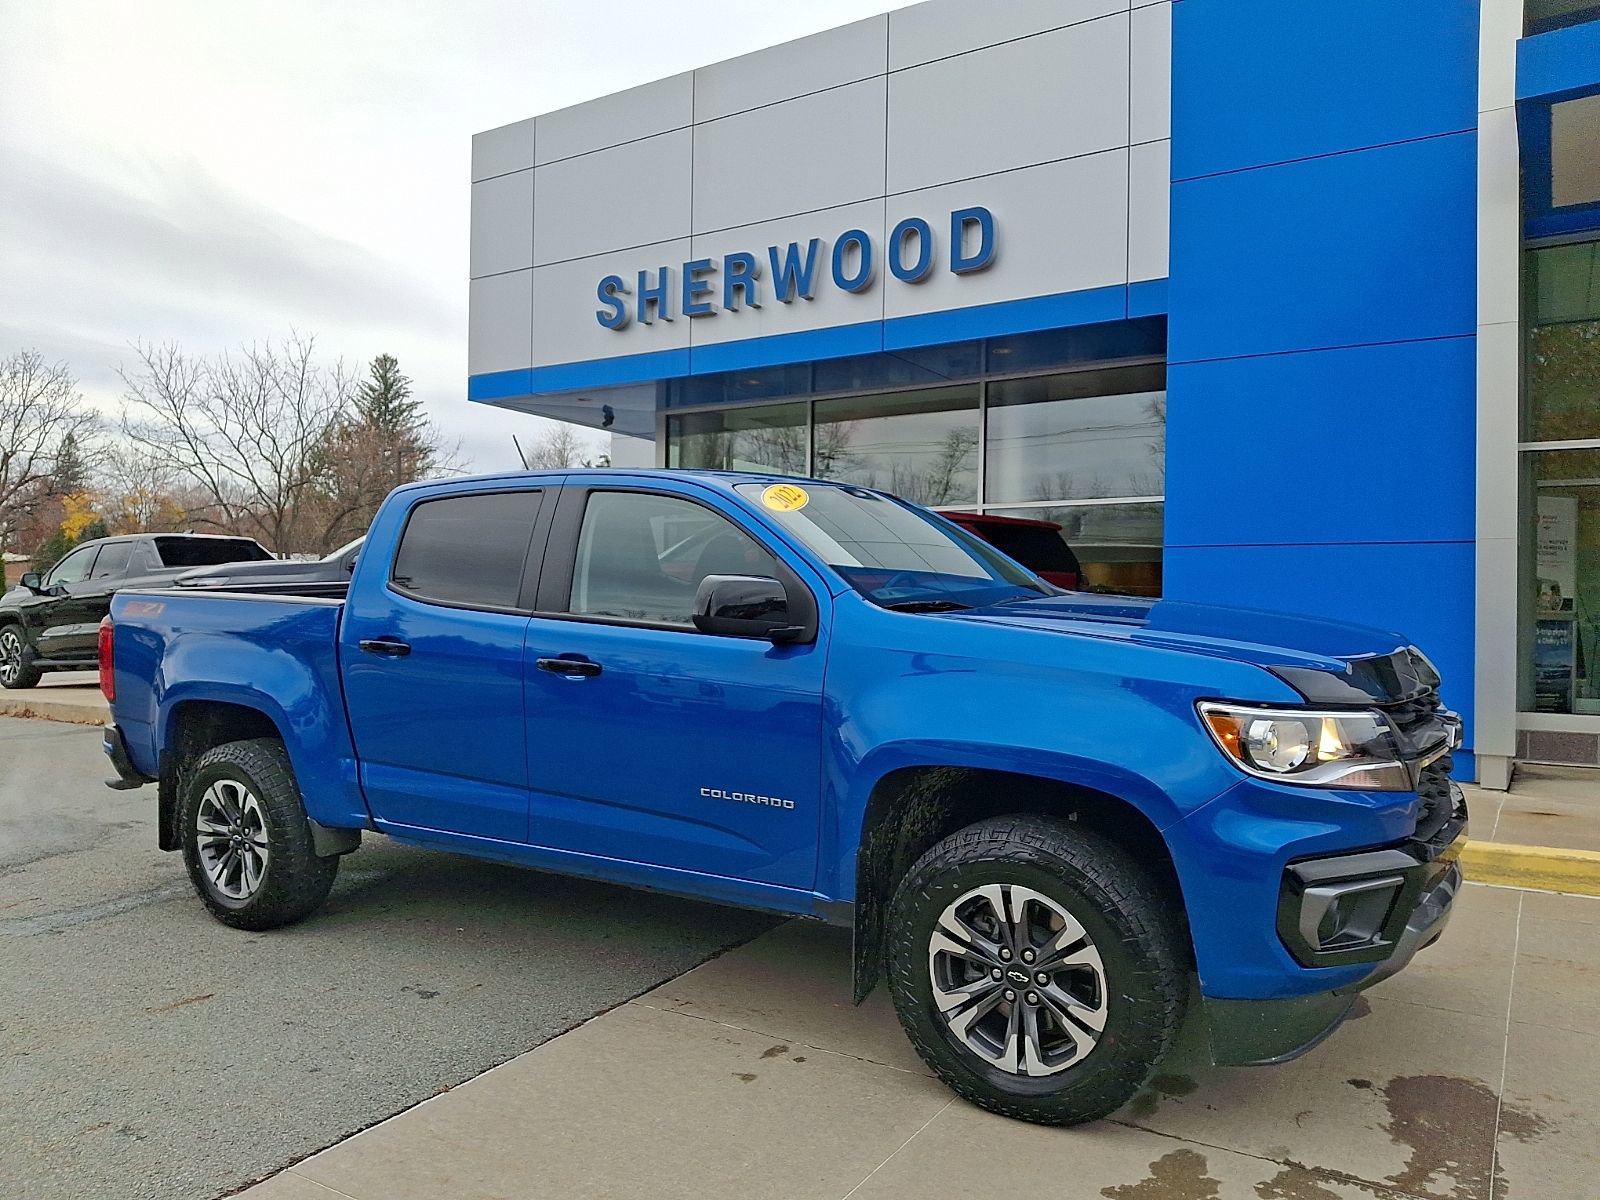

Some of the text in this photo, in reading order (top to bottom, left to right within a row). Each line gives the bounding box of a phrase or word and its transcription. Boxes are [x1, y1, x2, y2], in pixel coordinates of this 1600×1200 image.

[596, 206, 999, 331] SHERWOOD
[769, 486, 802, 508] 2022
[700, 788, 795, 809] COLORADO
